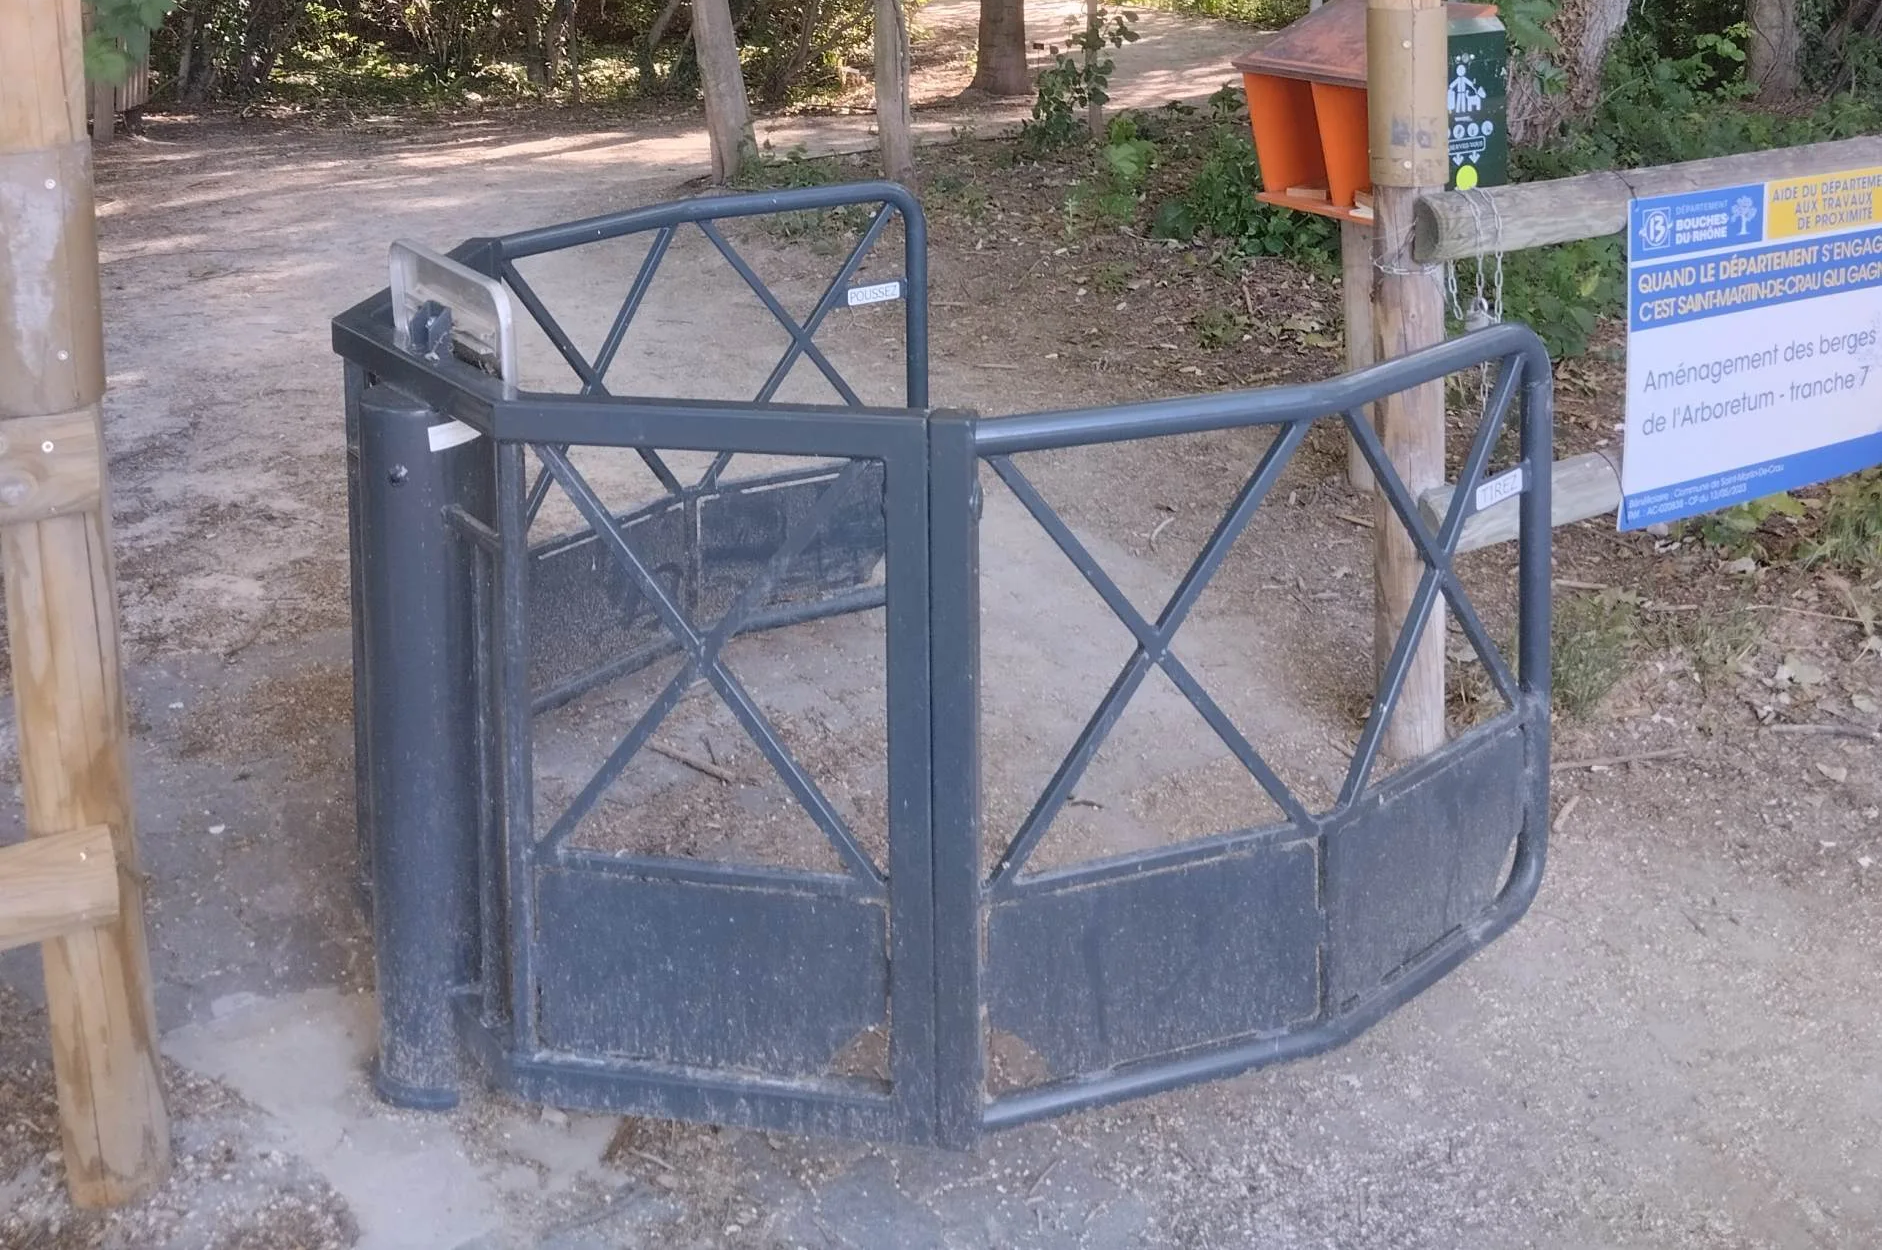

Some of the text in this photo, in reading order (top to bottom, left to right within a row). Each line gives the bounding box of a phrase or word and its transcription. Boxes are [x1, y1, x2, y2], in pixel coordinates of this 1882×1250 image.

[1773, 186, 1798, 202] AIDE
[1802, 183, 1817, 198] DU
[1795, 191, 1873, 214] AUX TRAVAUX
[1649, 215, 1666, 242] 13
[1797, 216, 1811, 230] DE
[1638, 266, 1697, 295] QUAND
[1700, 262, 1716, 284] LE
[1719, 246, 1819, 280] DÉPARTEMENT
[849, 284, 898, 303] POUSSEZ
[1638, 297, 1677, 323] C'EST
[1677, 271, 1822, 316] SAINT-MARTIN-DE-CRAU
[1823, 267, 1846, 288] QUI
[1643, 329, 1877, 393] Aménagement des berges
[1642, 412, 1667, 436] de
[1672, 390, 1775, 429] l'Arboretum
[1789, 371, 1856, 402] tranche
[1860, 365, 1871, 387] 7
